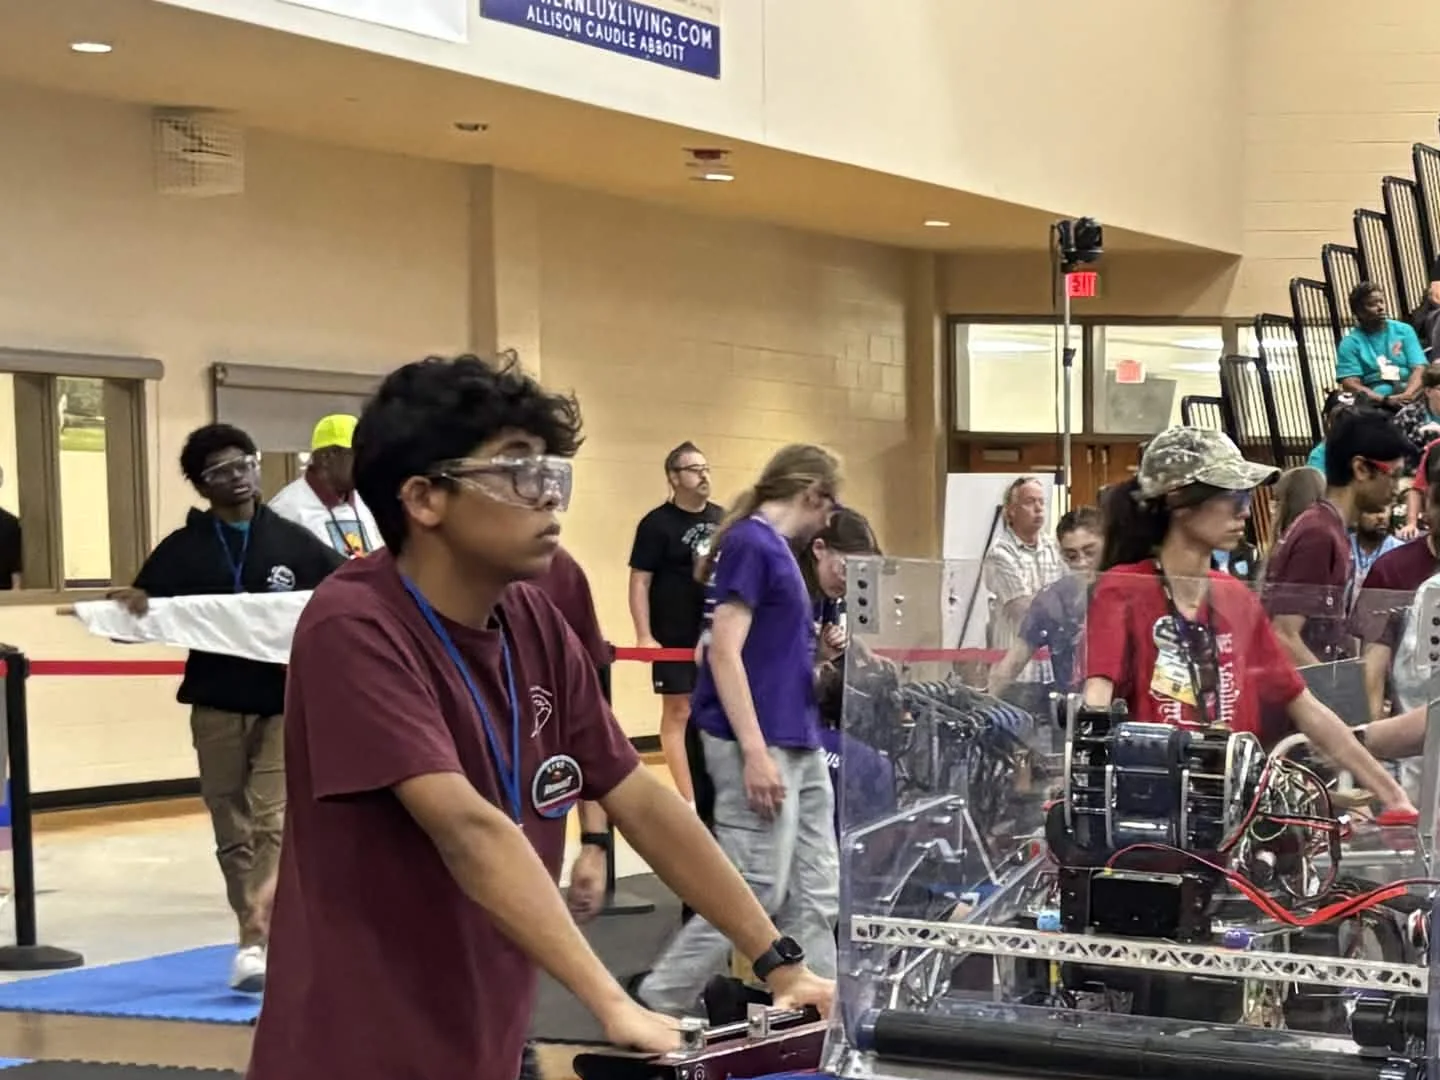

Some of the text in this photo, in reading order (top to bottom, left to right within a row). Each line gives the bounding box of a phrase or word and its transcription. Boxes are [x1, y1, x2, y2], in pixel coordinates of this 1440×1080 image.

[527, 5, 685, 62] ALLISON CAUDLE ABBOTT
[541, 0, 712, 49] RNLUXLIVING.COM
